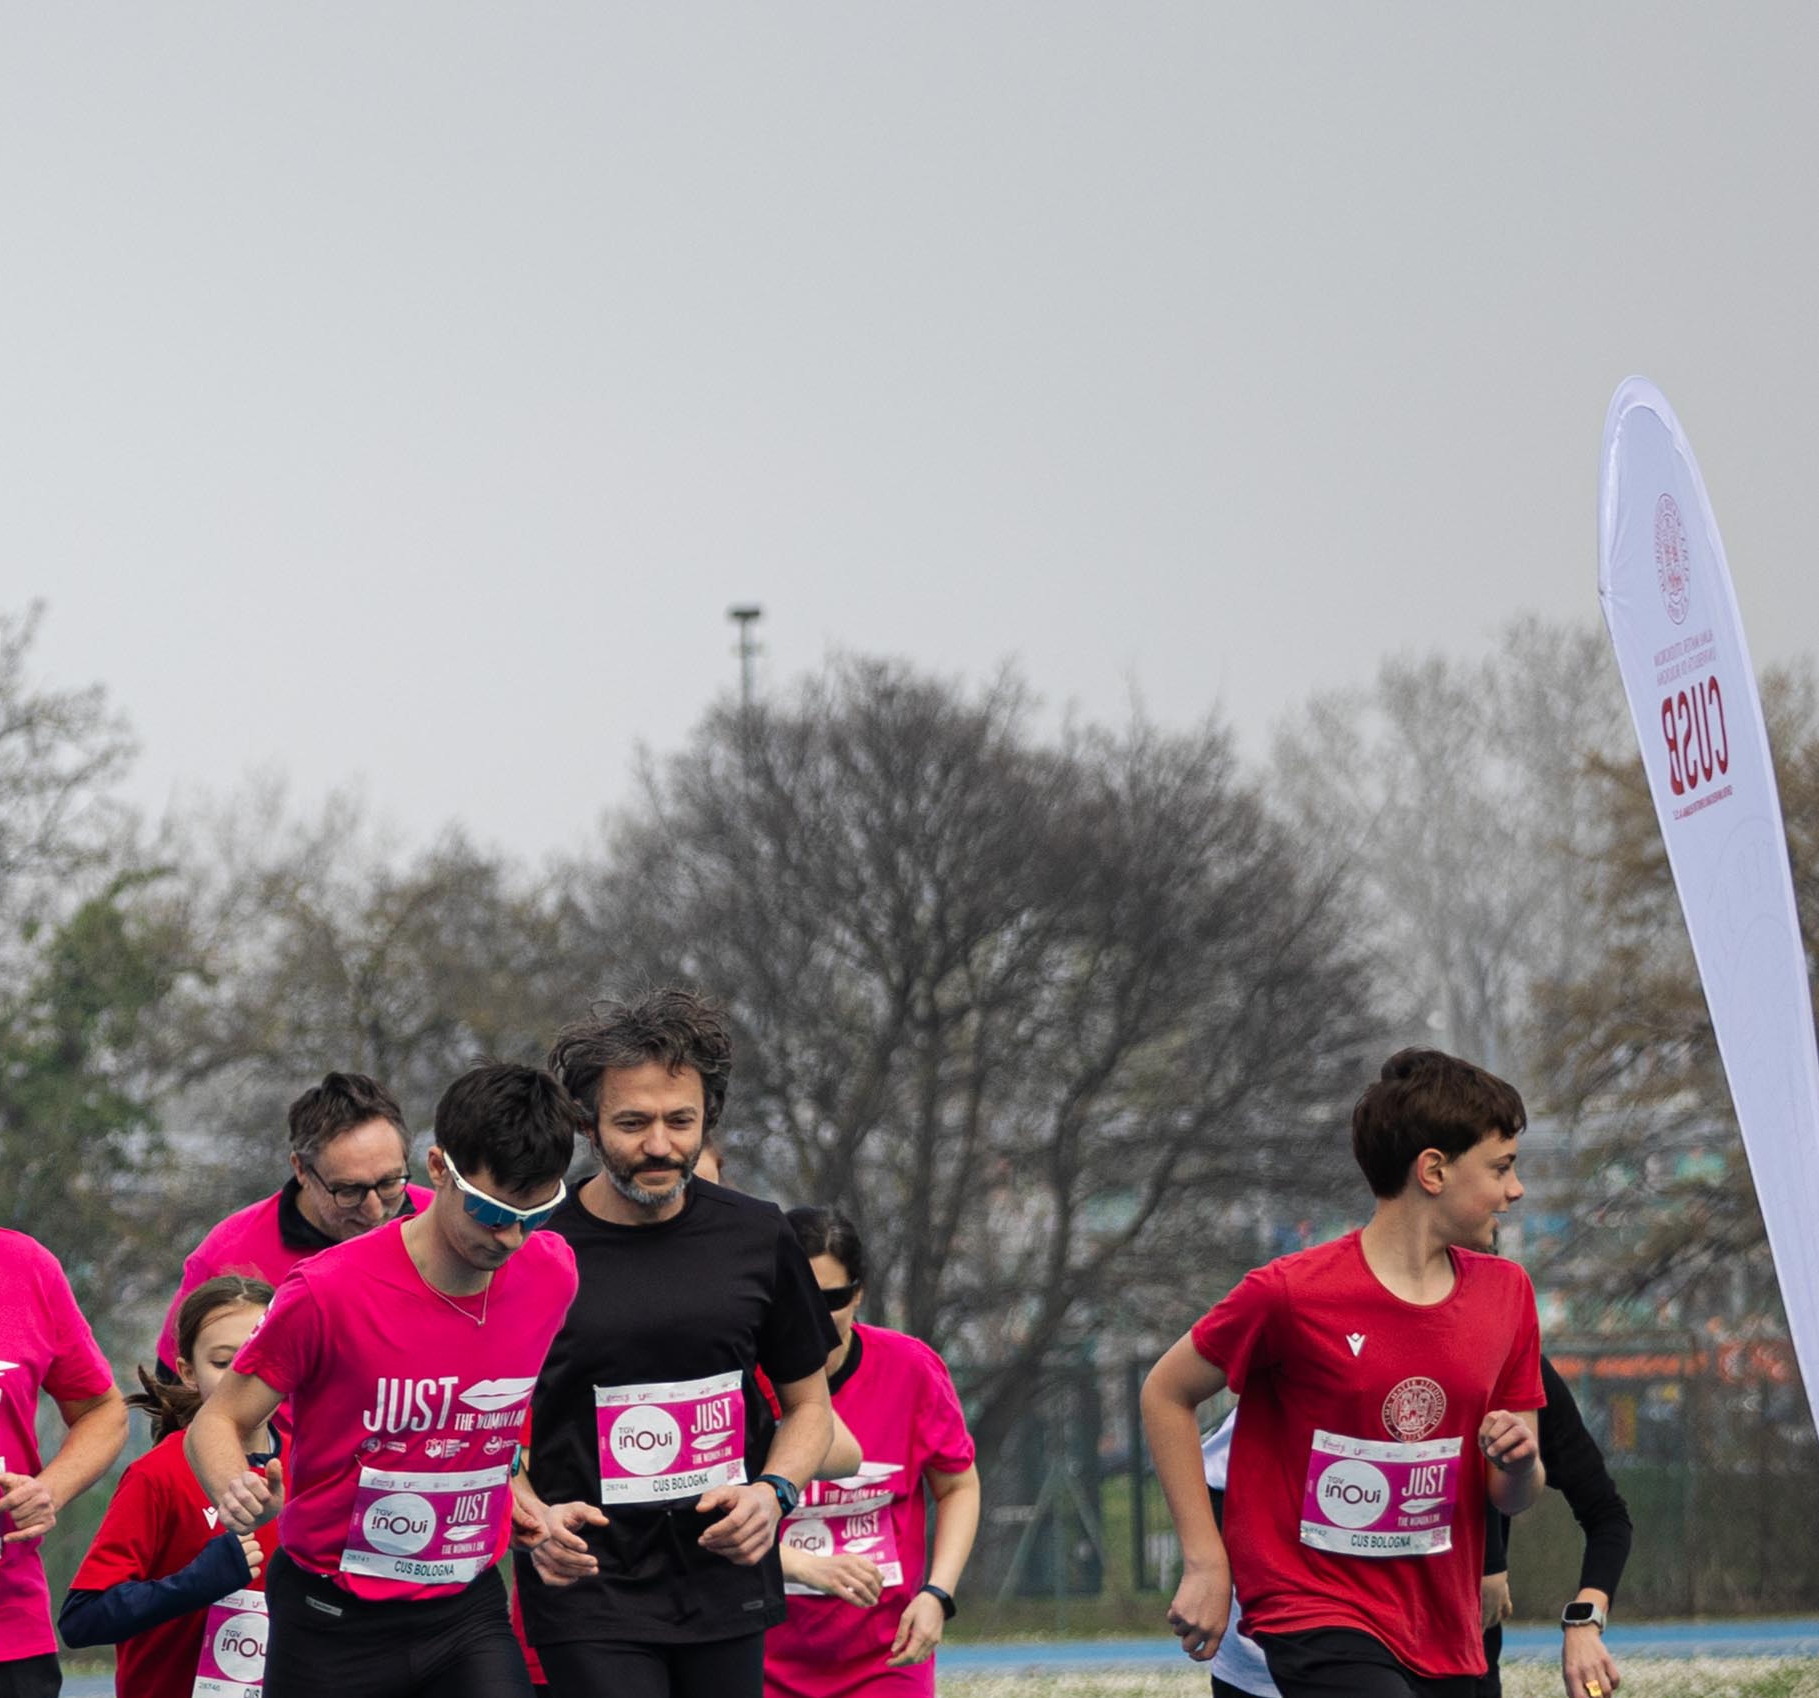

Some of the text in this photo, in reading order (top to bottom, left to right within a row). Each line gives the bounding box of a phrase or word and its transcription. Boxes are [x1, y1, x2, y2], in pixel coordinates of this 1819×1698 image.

[363, 1376, 459, 1433] JUST
[454, 1413, 474, 1431] THE
[691, 1398, 731, 1434] JUST
[653, 1473, 709, 1492] CUS BOLOGNA
[1327, 1475, 1345, 1484] TGV
[1401, 1464, 1448, 1497] JUST
[375, 1508, 393, 1517] TGV
[446, 1492, 492, 1524] JUST
[841, 1511, 879, 1539] JUST
[1351, 1534, 1411, 1548] CUS BOLOGNA
[394, 1560, 455, 1577] CUS BOLOGNA
[225, 1629, 241, 1638] TGV
[221, 1638, 266, 1657] inOu
